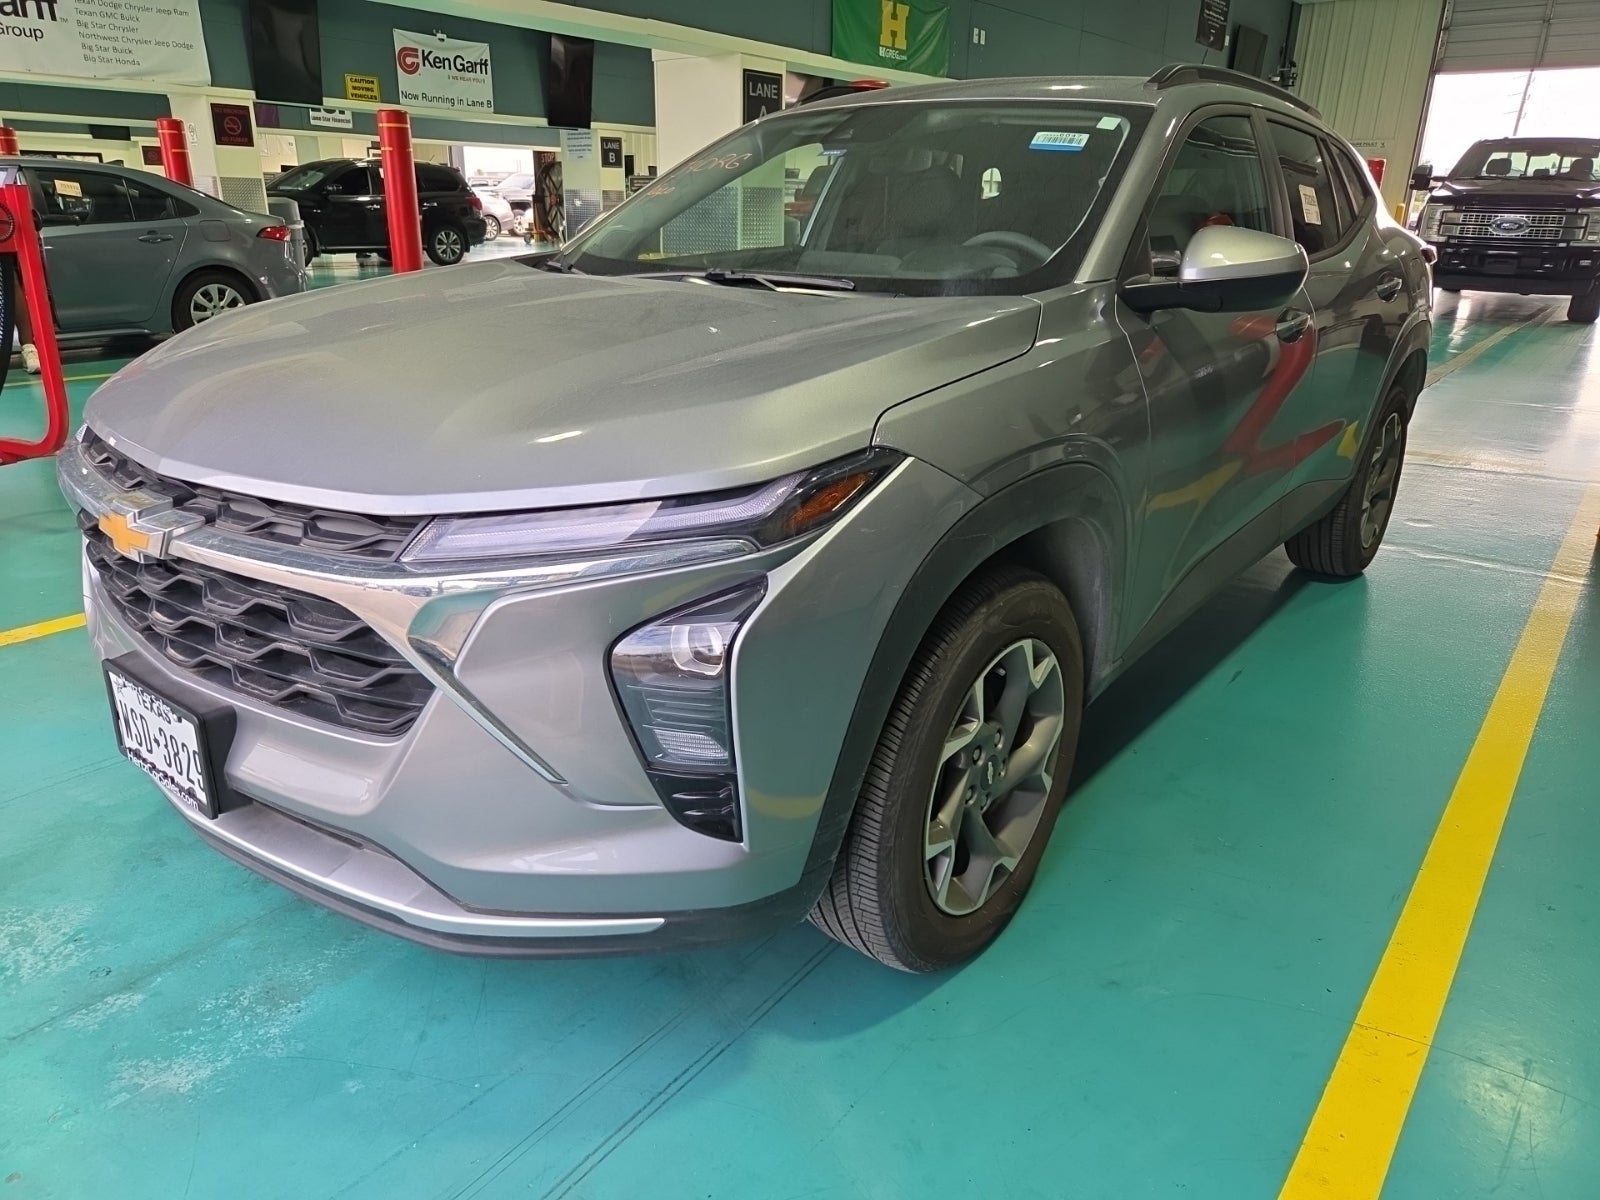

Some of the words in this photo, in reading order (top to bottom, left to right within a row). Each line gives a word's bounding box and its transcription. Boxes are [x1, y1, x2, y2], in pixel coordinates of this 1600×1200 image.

[97, 0, 122, 10] Dodge
[124, 3, 153, 13] Chrysler
[155, 7, 172, 16] Jeep
[173, 8, 189, 16] Ram
[74, 8, 97, 17] Texan
[99, 11, 119, 20] GMC
[120, 13, 140, 22] Buick
[76, 19, 89, 29] Big
[90, 21, 106, 30] Star
[108, 23, 139, 34] Chrysler
[79, 31, 120, 42] Northwest
[121, 35, 152, 46] Chrysler
[154, 39, 171, 48] Jeep
[171, 40, 194, 50] Dodge
[81, 42, 94, 52] Big
[94, 44, 110, 52] Star
[112, 46, 132, 54] Buick
[83, 54, 96, 63] Big
[97, 55, 113, 64] Star
[115, 58, 141, 66] Honda
[421, 49, 452, 71] Ken
[453, 54, 489, 76] Garff
[350, 77, 375, 85] CAUTION
[350, 92, 378, 101] VEHICLES
[749, 81, 778, 99] LANE
[401, 90, 419, 100] Now
[421, 92, 455, 107] Running
[457, 96, 465, 105] in
[466, 97, 485, 107] Lane
[486, 100, 493, 109] B
[603, 141, 620, 150] LANE
[541, 152, 555, 162] STOP
[608, 152, 616, 163] B
